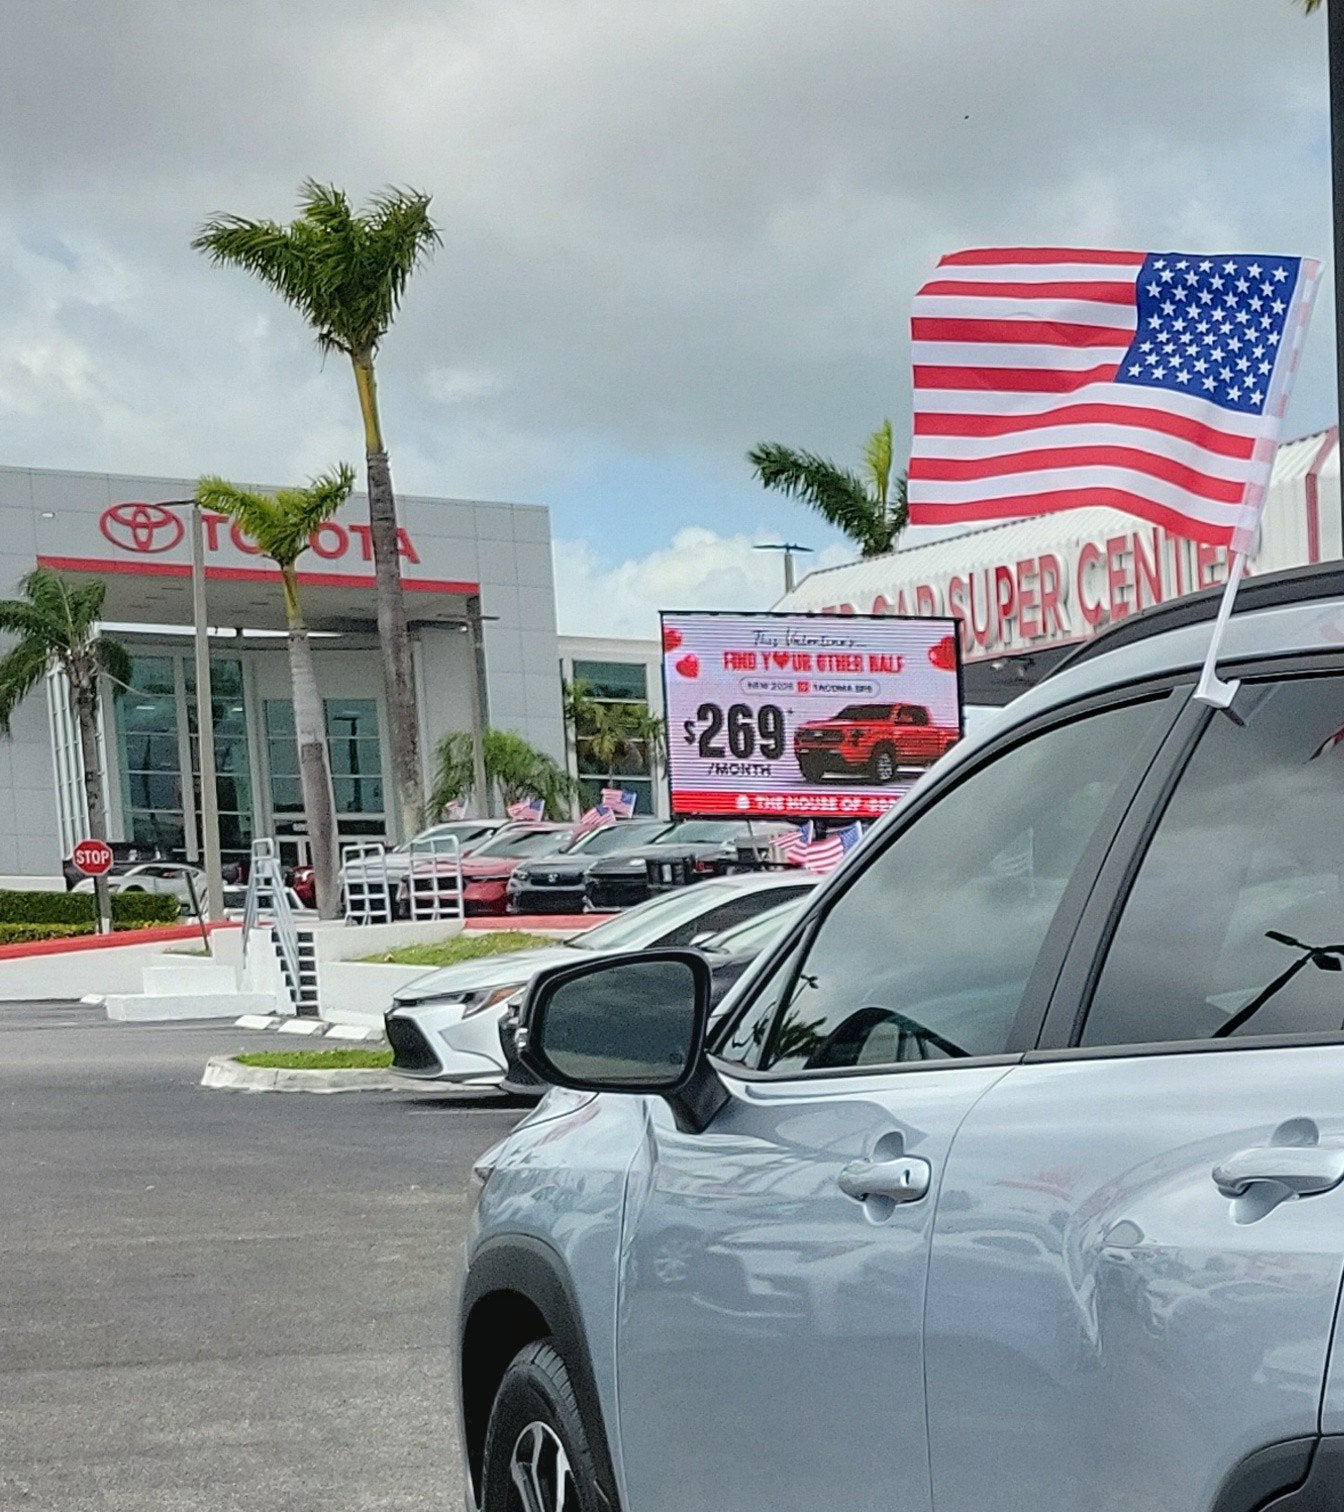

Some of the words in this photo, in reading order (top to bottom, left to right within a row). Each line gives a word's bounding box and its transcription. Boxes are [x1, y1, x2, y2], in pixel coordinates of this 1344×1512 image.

[201, 512, 421, 564] TOOTA
[947, 552, 1064, 650] SUPER
[755, 795, 785, 810] THE
[785, 796, 838, 812] HOUSE
[76, 849, 110, 865] STOP
